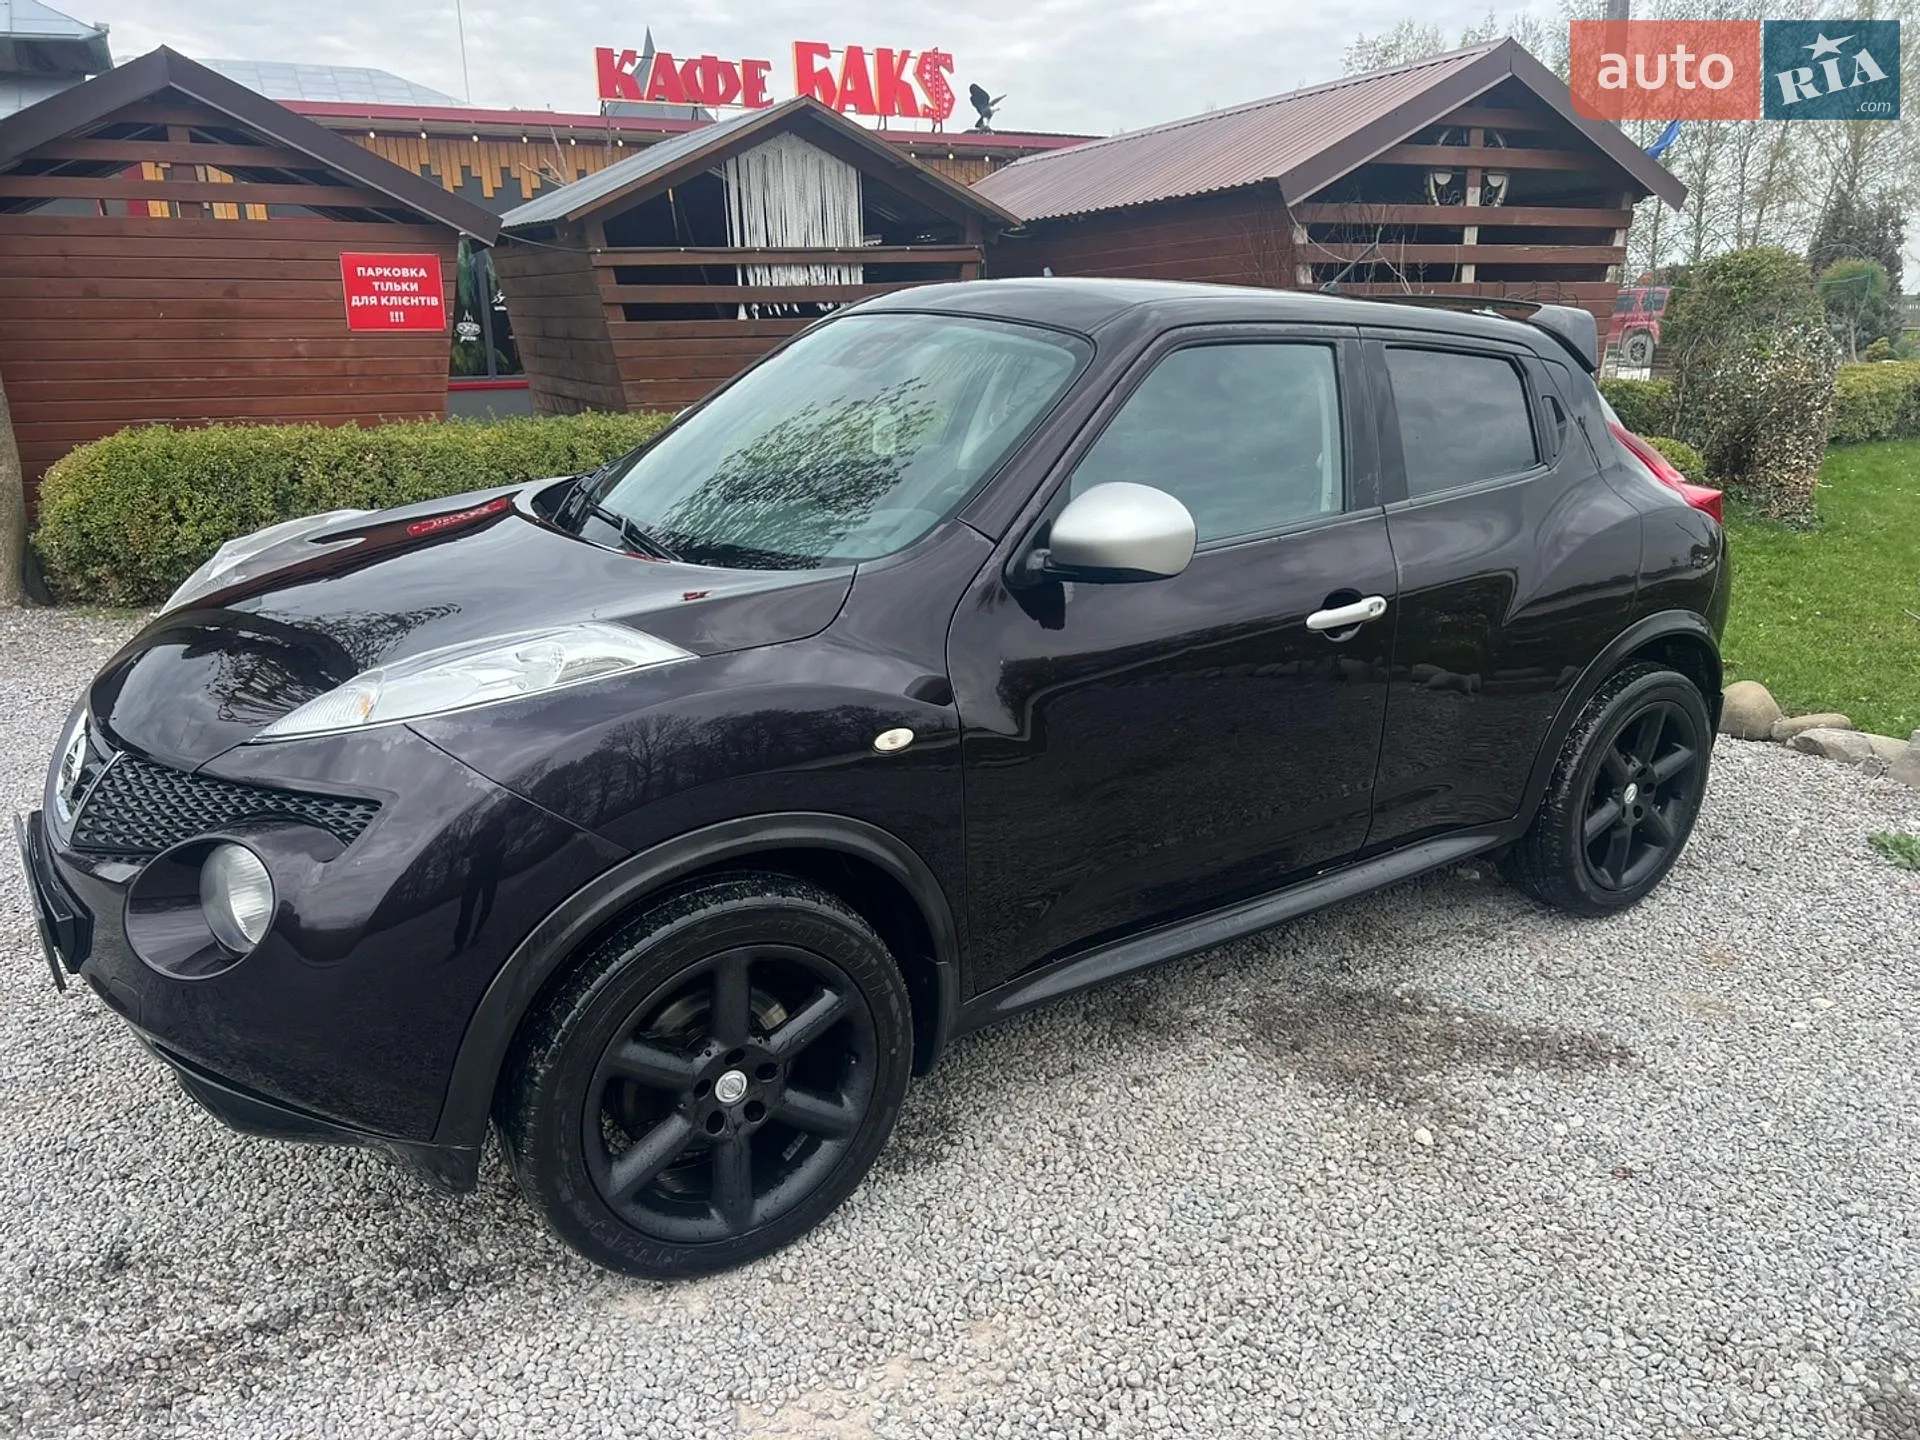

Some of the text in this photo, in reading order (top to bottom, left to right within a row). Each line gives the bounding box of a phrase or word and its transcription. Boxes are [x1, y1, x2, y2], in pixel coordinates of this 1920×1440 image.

[595, 47, 774, 108] КАФЕ
[356, 266, 428, 278] ПАРКОВКА
[372, 281, 419, 292] ТІЛЬКИ
[351, 295, 439, 307] ДЛЯ КЛІЄНТІВ
[389, 311, 405, 323] !!!
